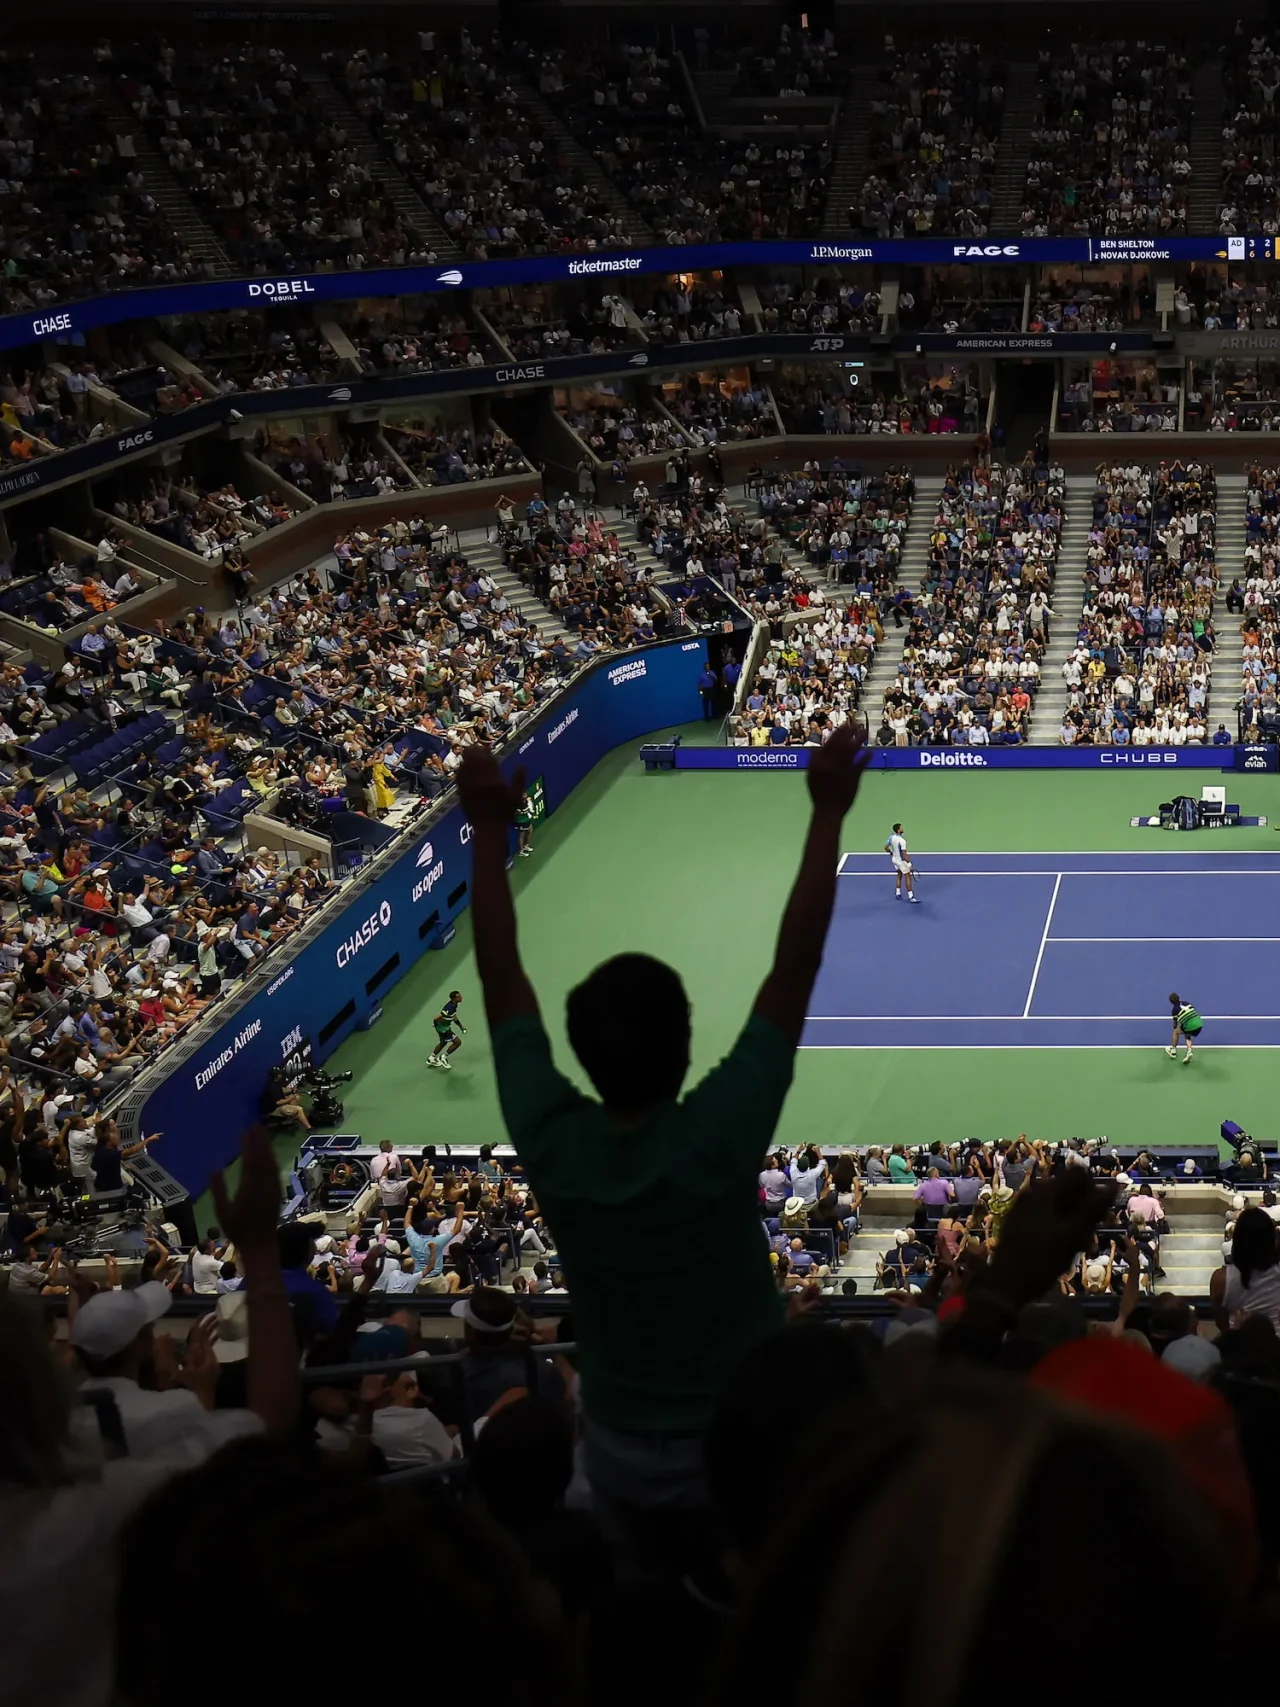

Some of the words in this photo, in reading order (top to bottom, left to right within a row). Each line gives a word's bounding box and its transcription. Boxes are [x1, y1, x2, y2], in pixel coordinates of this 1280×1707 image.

[953, 246, 1020, 256] FAGE
[1101, 240, 1117, 248] BEN
[1118, 240, 1154, 248] SHELTON
[810, 246, 872, 261] J.P.Morgan
[1101, 251, 1128, 259] NOVAK
[1130, 251, 1170, 259] DJOKOVIC
[1249, 250, 1255, 258] 6
[1265, 250, 1271, 258] 6
[568, 257, 642, 274] ticketmaster
[248, 280, 315, 296] DOBEL
[270, 294, 298, 302] TEQUILA
[32, 314, 72, 336] CHASE
[810, 338, 845, 352] ATP
[956, 339, 1006, 348] AMERICAN
[1008, 338, 1053, 348] EXPRESS
[496, 366, 545, 382] CHASE
[118, 430, 154, 451] FAGE
[15, 471, 41, 488] LAUREN
[682, 642, 700, 651] USTA
[608, 660, 646, 680] AMERICAN
[613, 668, 647, 686] EXPRESS
[548, 720, 566, 744] Emirates
[565, 708, 579, 726] Airline
[738, 752, 798, 764] moderna
[920, 752, 988, 766] Deloitte.
[1100, 753, 1178, 763] CHUBB
[1244, 760, 1266, 768] evian
[412, 880, 422, 902] us
[422, 860, 444, 894] open
[336, 912, 380, 968] CHASE
[266, 966, 294, 996] USOPEN.ORG
[280, 1024, 303, 1058] IBM
[194, 1046, 234, 1090] Emirates
[234, 1018, 262, 1054] Airline
